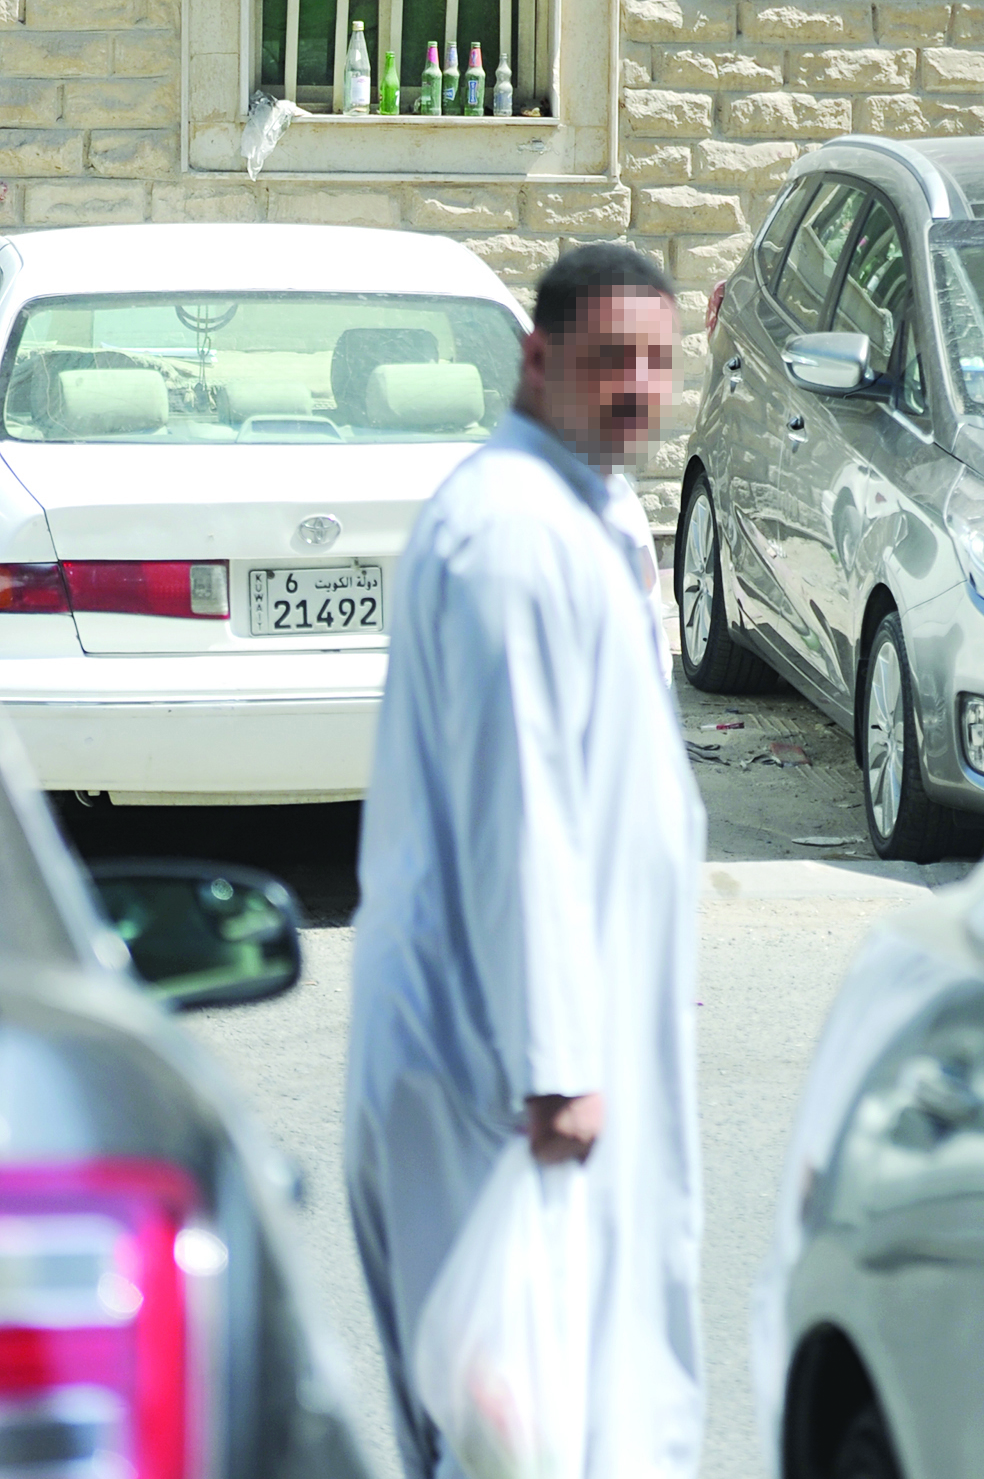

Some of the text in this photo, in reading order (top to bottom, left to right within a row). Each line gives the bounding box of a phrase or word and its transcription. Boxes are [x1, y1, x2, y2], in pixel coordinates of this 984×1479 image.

[285, 573, 298, 594] 6
[314, 575, 378, 592] دولة الكويت
[253, 574, 265, 631] KUWAIT
[273, 597, 377, 630] 21492
